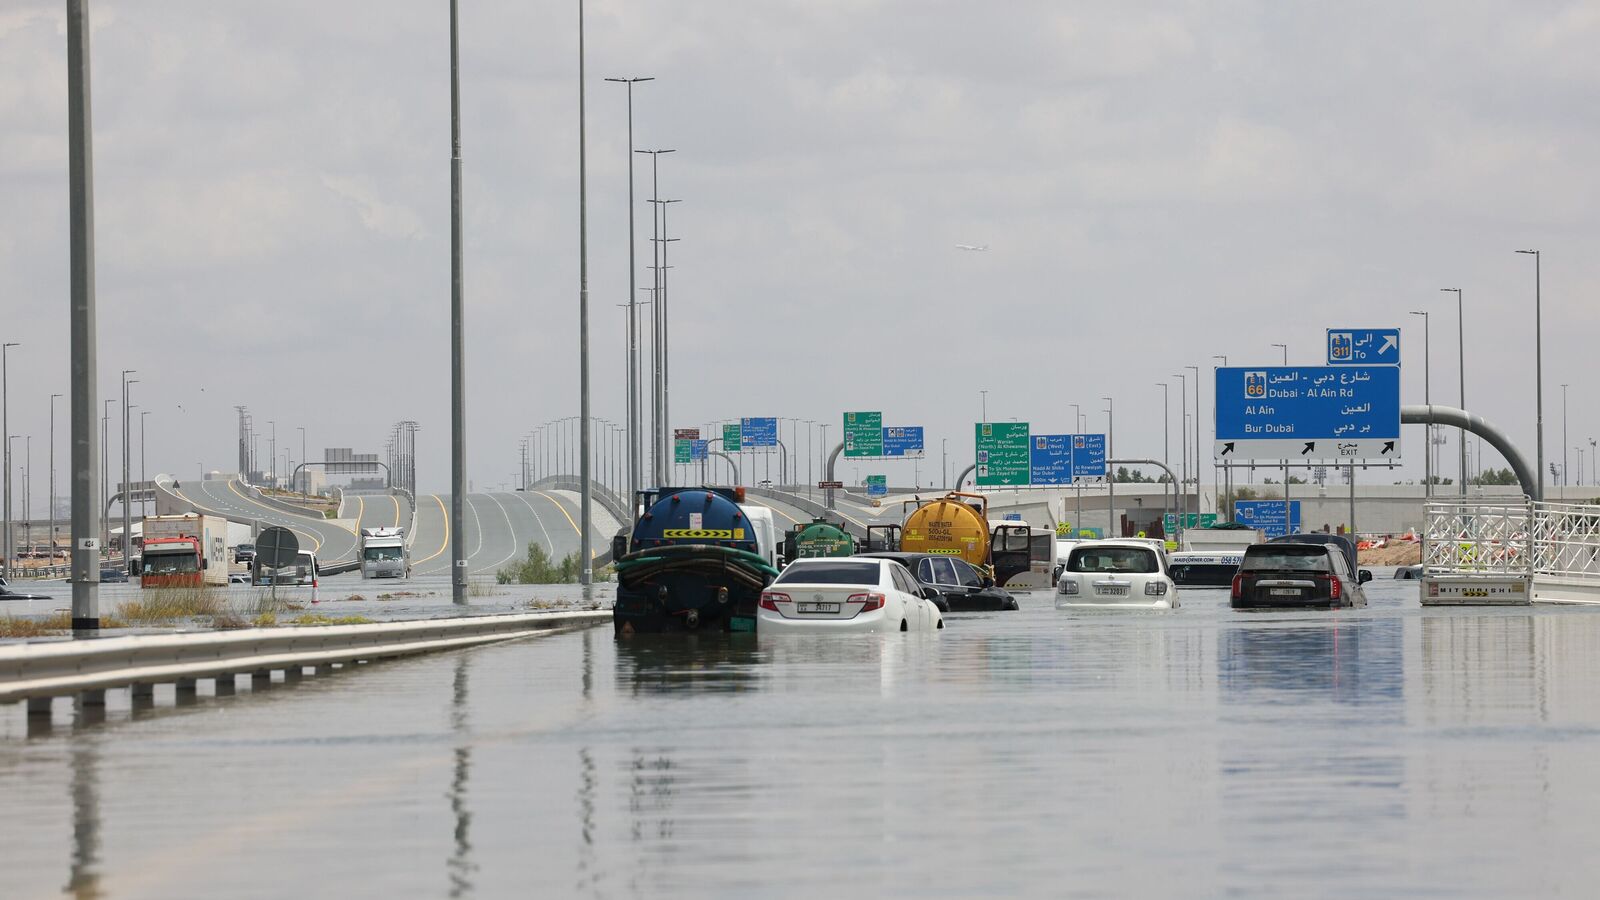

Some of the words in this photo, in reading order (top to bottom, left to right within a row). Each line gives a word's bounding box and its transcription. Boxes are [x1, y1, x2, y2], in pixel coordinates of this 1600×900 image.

[1355, 334, 1372, 348] إلى
[1334, 346, 1349, 357] 311
[1354, 350, 1366, 359] To
[1269, 372, 1298, 384] العين
[1314, 374, 1334, 386] دبي
[1340, 372, 1370, 384] شارع
[1248, 385, 1264, 396] 66
[1269, 388, 1298, 398] Dubai
[1307, 388, 1318, 398] Al
[1320, 388, 1337, 398] Ain
[1340, 388, 1353, 398] Rd
[1246, 406, 1256, 415] Al
[1258, 406, 1274, 415] Ain
[1341, 403, 1370, 415] العين
[1246, 424, 1262, 433] Bur
[1266, 424, 1294, 433] Dubai
[1334, 424, 1354, 436] دبي
[1359, 425, 1370, 434] بر
